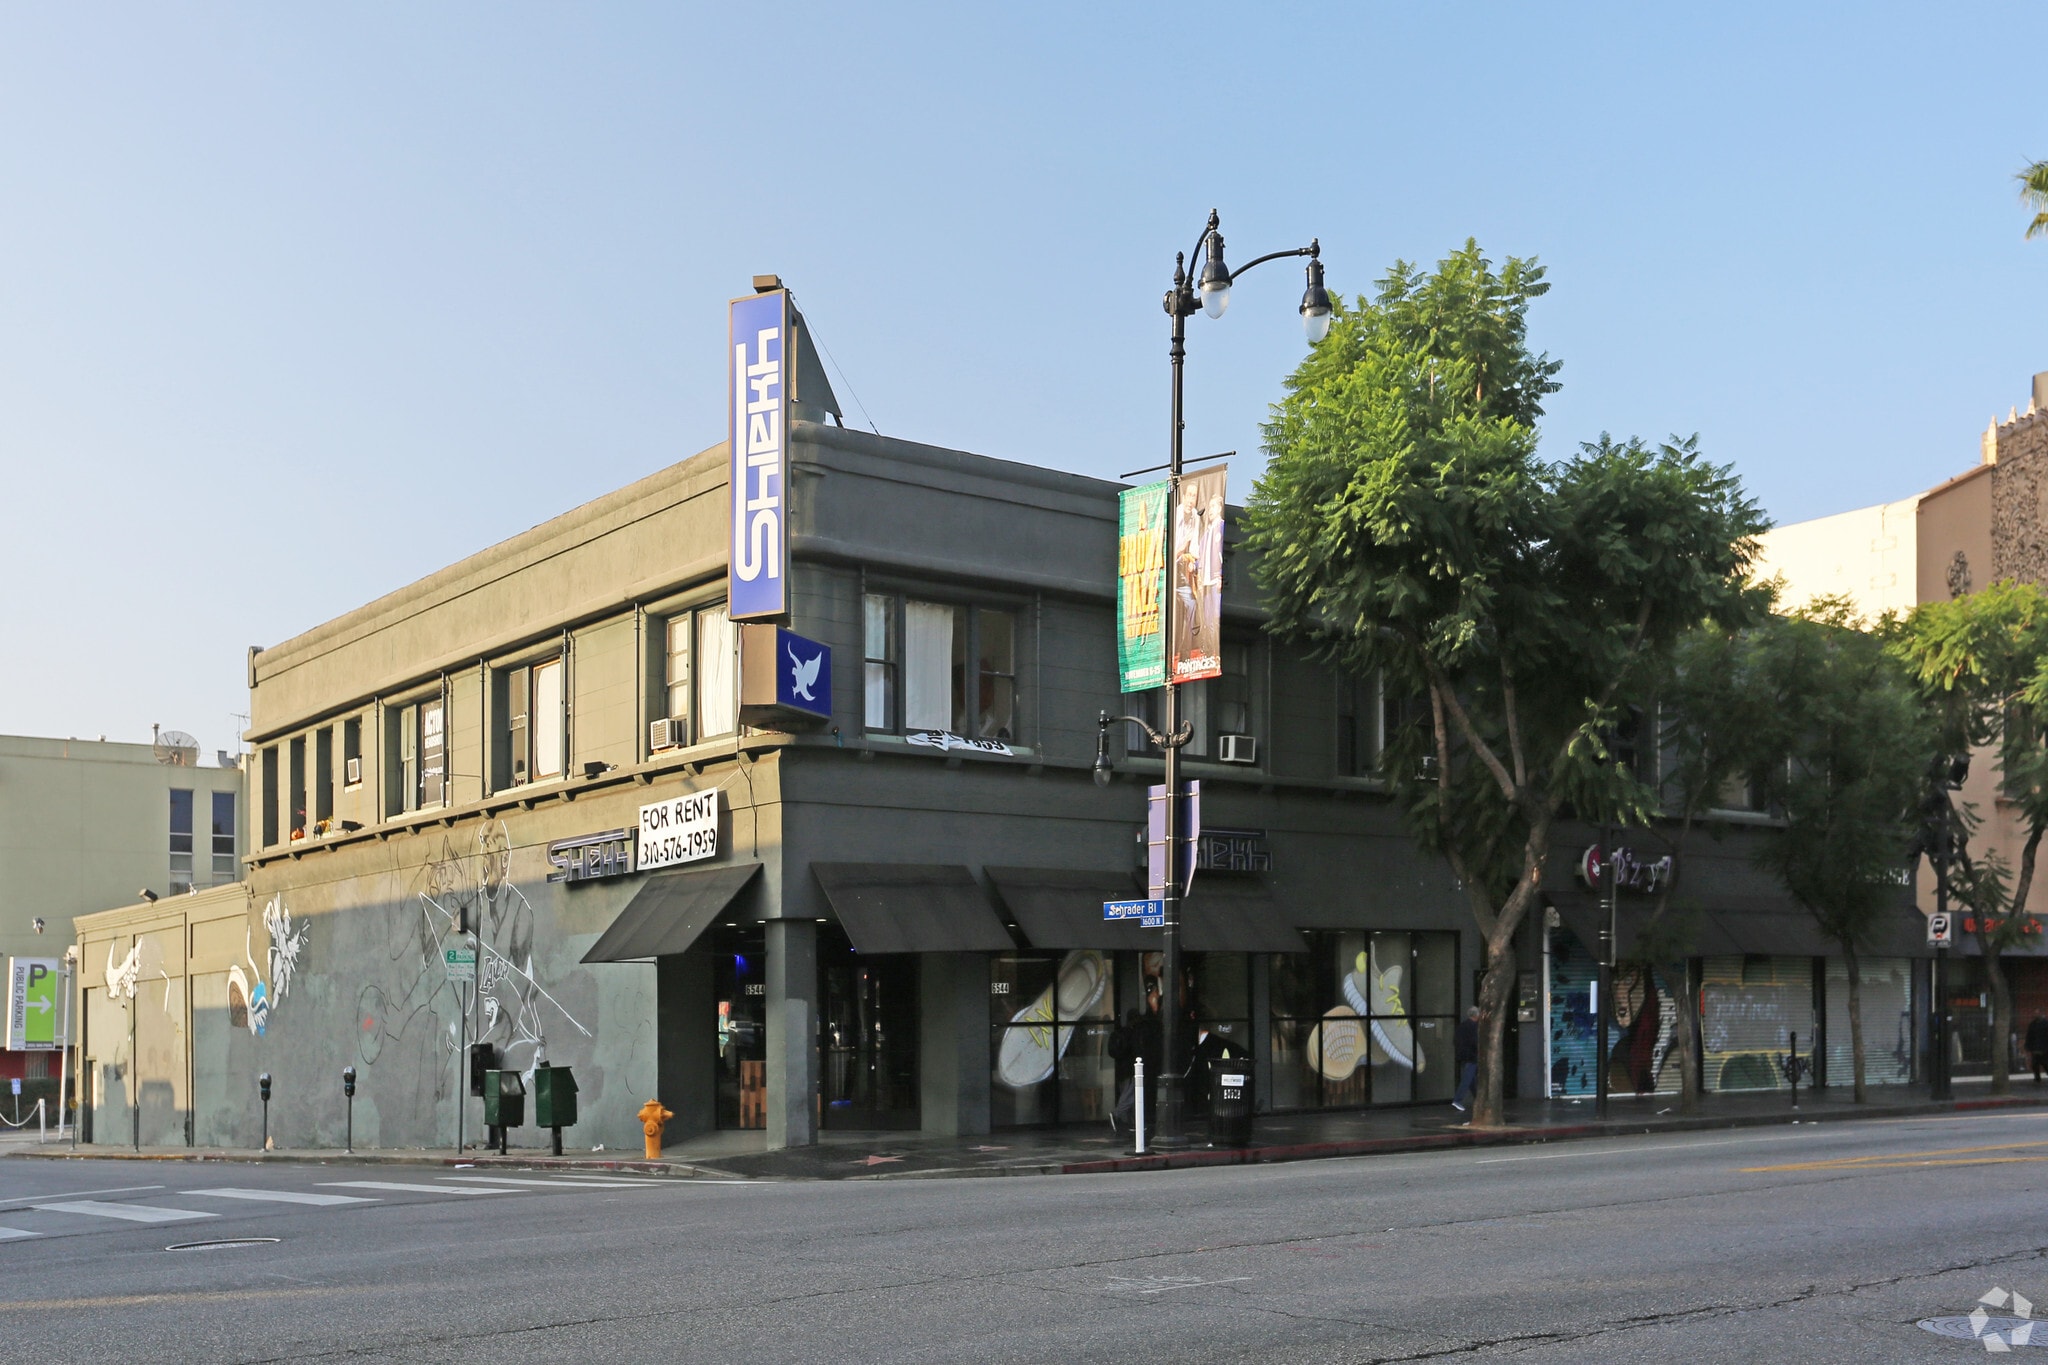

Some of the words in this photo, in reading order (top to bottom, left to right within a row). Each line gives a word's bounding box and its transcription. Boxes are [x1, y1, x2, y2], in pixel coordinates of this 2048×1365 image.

[1125, 570, 1159, 615] TALE
[1177, 657, 1217, 675] PANTAGES
[643, 806, 669, 832] FOR
[675, 793, 714, 825] RENT
[641, 828, 716, 866] 310-576-7959
[1109, 902, 1145, 916] Schrader
[1142, 917, 1155, 926] 1600
[448, 951, 456, 960] 2
[15, 966, 25, 993] PUBLIC
[29, 964, 48, 988] P
[745, 983, 766, 995] 6544
[991, 982, 1010, 994] 6544
[14, 995, 25, 1029] PARKING
